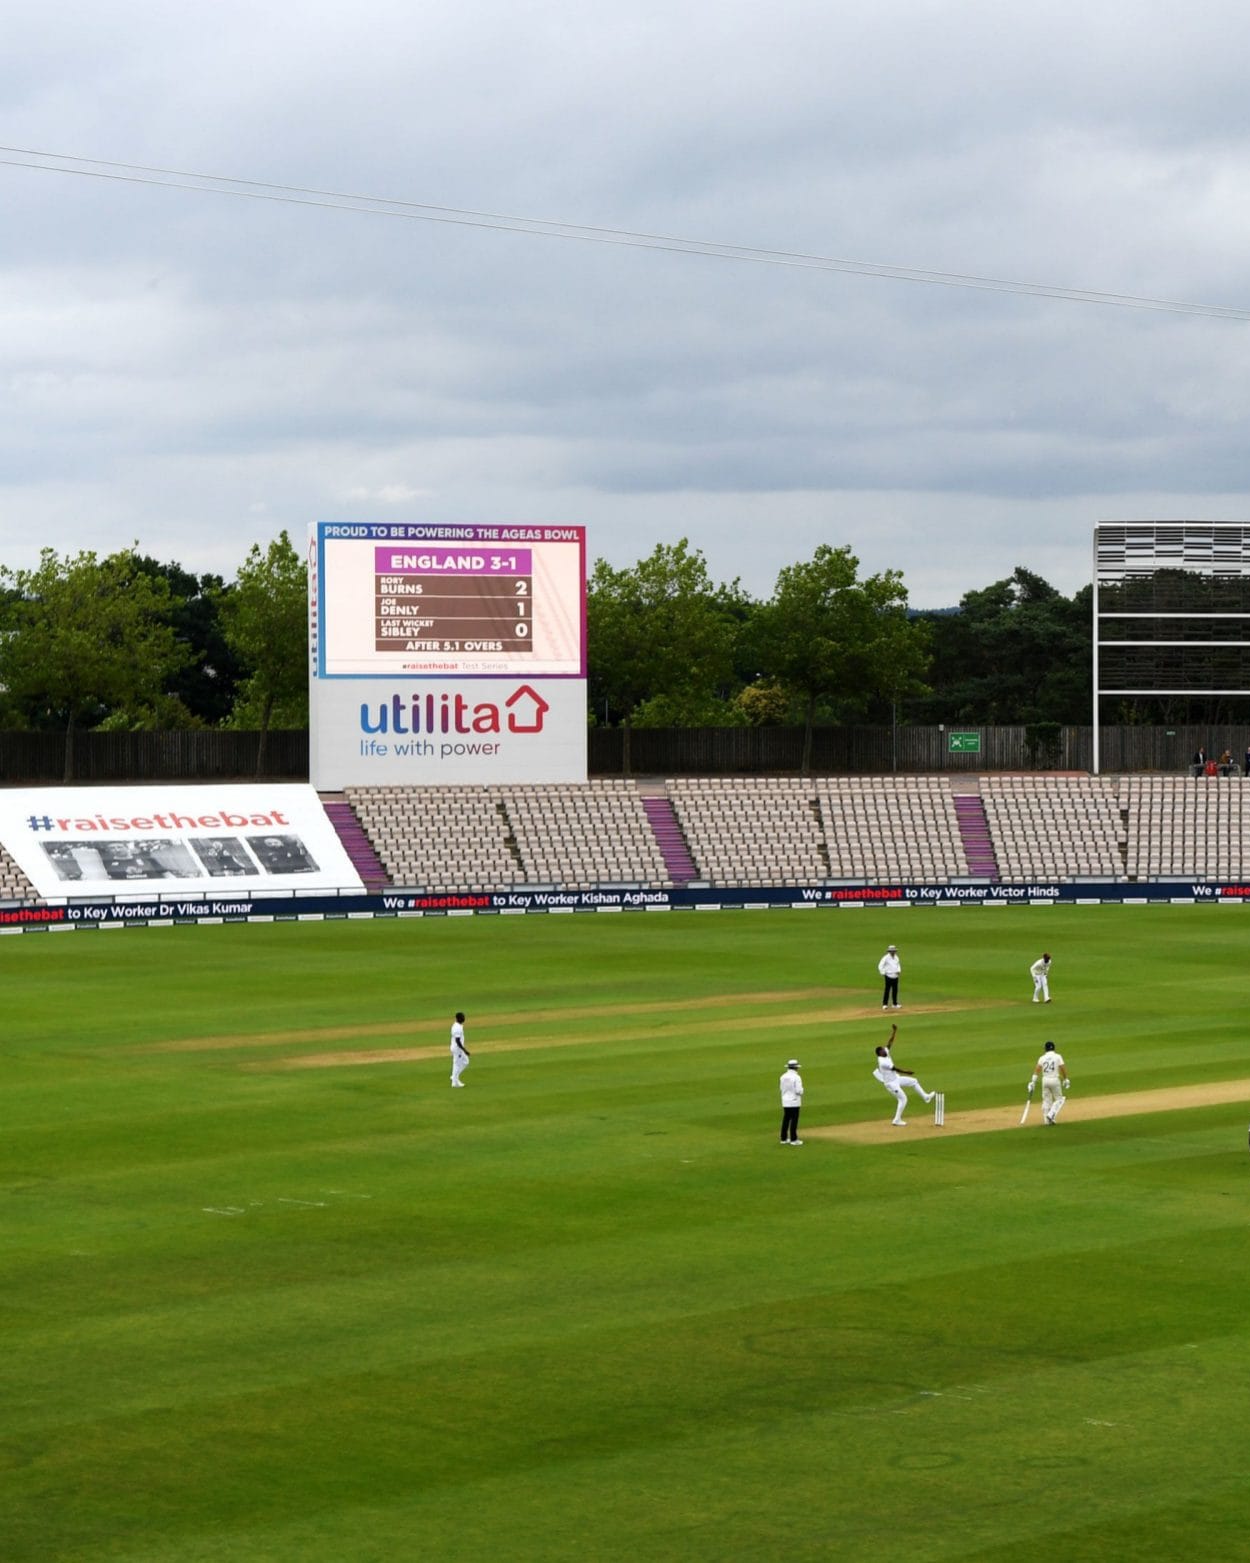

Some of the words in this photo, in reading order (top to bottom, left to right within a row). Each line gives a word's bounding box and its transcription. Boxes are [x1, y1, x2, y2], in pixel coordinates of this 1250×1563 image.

[325, 527, 368, 537] PROUD
[371, 527, 387, 537] TO
[391, 527, 405, 538] BE
[408, 527, 474, 539] POWERING
[477, 528, 499, 538] THE
[502, 529, 541, 540] AGEAS
[545, 529, 579, 540] BOWL
[391, 555, 485, 570] ENGLAND
[490, 556, 516, 570] 3-1
[381, 584, 423, 594] BURNS
[516, 582, 527, 595] 2
[381, 605, 419, 616] DENLY
[517, 602, 525, 616] 1
[381, 627, 420, 637] SIBLEY
[516, 624, 527, 637] 0
[406, 641, 440, 651] AFTER
[443, 641, 460, 651] 5.1
[464, 641, 503, 651] OVERS
[361, 694, 500, 734] utilita
[360, 739, 387, 756] life
[394, 739, 434, 756] with
[440, 743, 500, 759] power
[27, 810, 289, 831] #raisethebat
[802, 889, 822, 900] We
[825, 888, 902, 899] #raisethebat
[905, 888, 918, 898] to
[920, 888, 942, 900] Key
[945, 887, 987, 898] Worker
[990, 886, 1025, 898] Victor
[1028, 886, 1060, 897] Hinds
[1192, 885, 1212, 896] We
[384, 898, 404, 909] We
[408, 895, 490, 908] #raisethebat
[493, 895, 506, 906] to
[508, 894, 532, 907] Key
[534, 893, 579, 905] Worker
[582, 892, 620, 904] Kishan
[623, 891, 669, 904] Aghada
[68, 908, 80, 919] to
[84, 906, 107, 920] Key
[111, 905, 157, 918] Worker
[160, 904, 175, 916] Dr
[177, 903, 210, 915] Vikas
[212, 902, 253, 914] Kumar
[1043, 1061, 1055, 1073] 24
